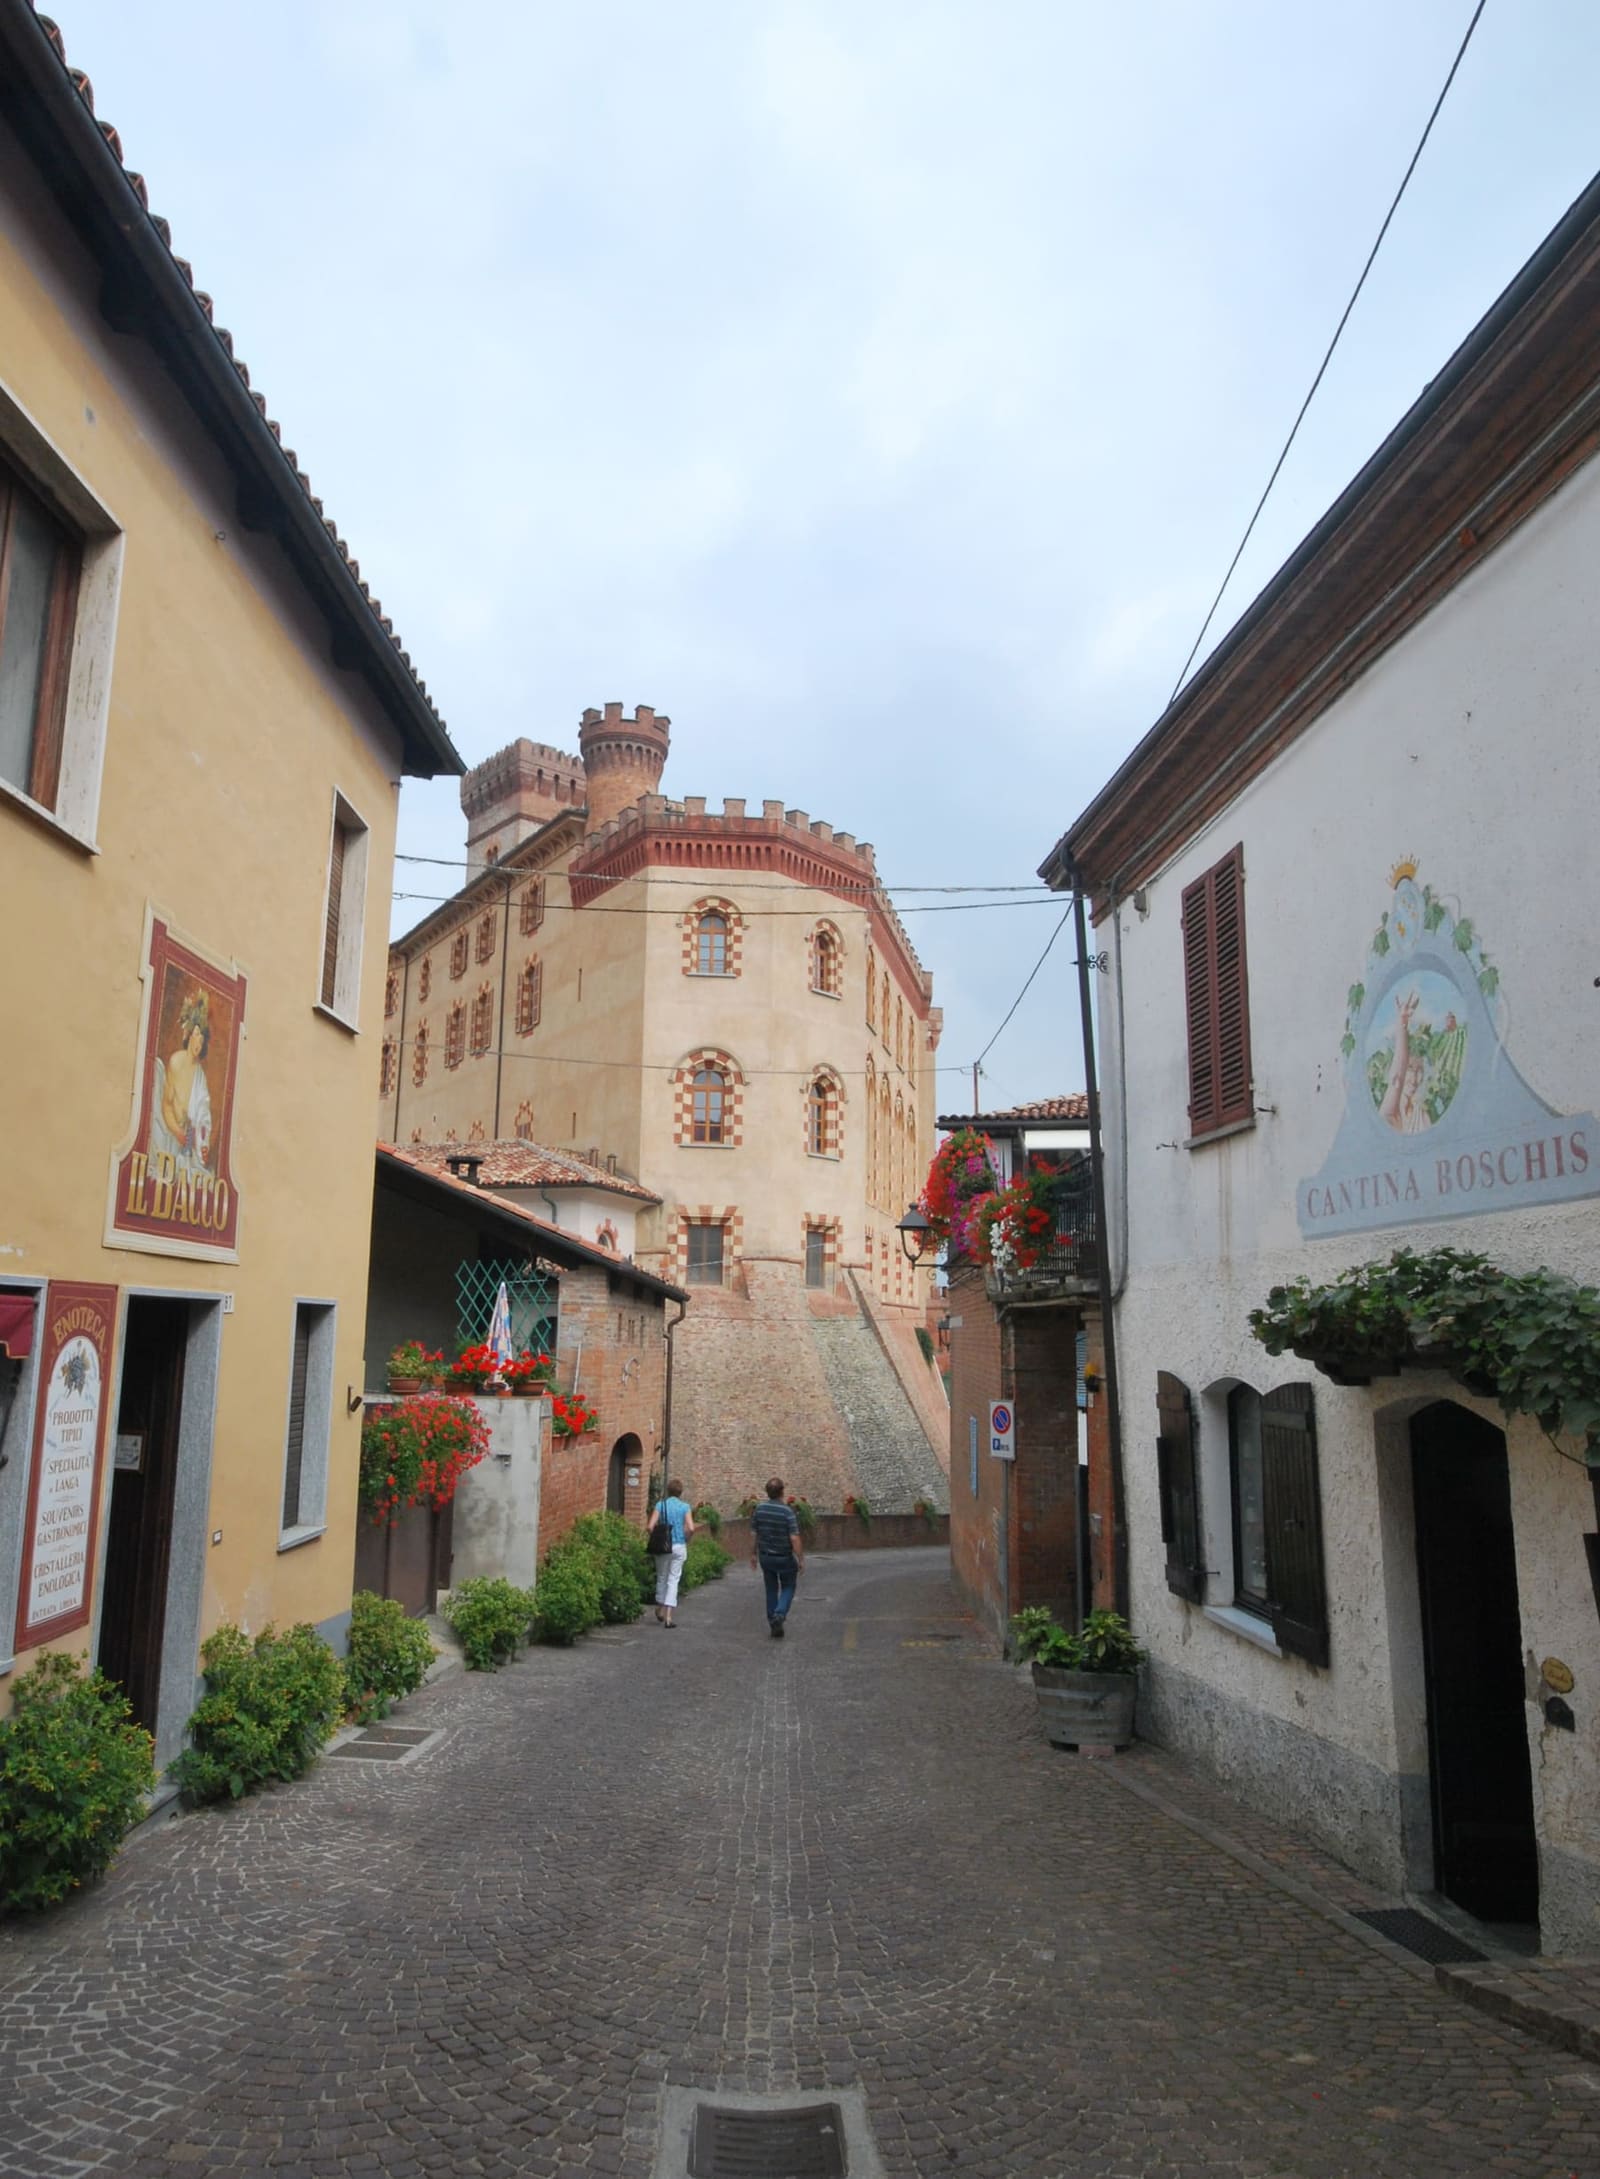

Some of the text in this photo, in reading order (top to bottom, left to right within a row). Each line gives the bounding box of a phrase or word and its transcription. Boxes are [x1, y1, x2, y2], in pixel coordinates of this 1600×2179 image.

[1307, 1131, 1590, 1218] CANTINA BOSCHIS
[126, 1151, 229, 1231] IL BACCO
[52, 1306, 107, 1353] ENOTECA
[52, 1408, 94, 1426] PRODOTTI
[61, 1428, 83, 1443] TIPICI
[34, 1551, 85, 1579] CRISTALLERIA
[38, 1569, 81, 1598] ENOLOGICA
